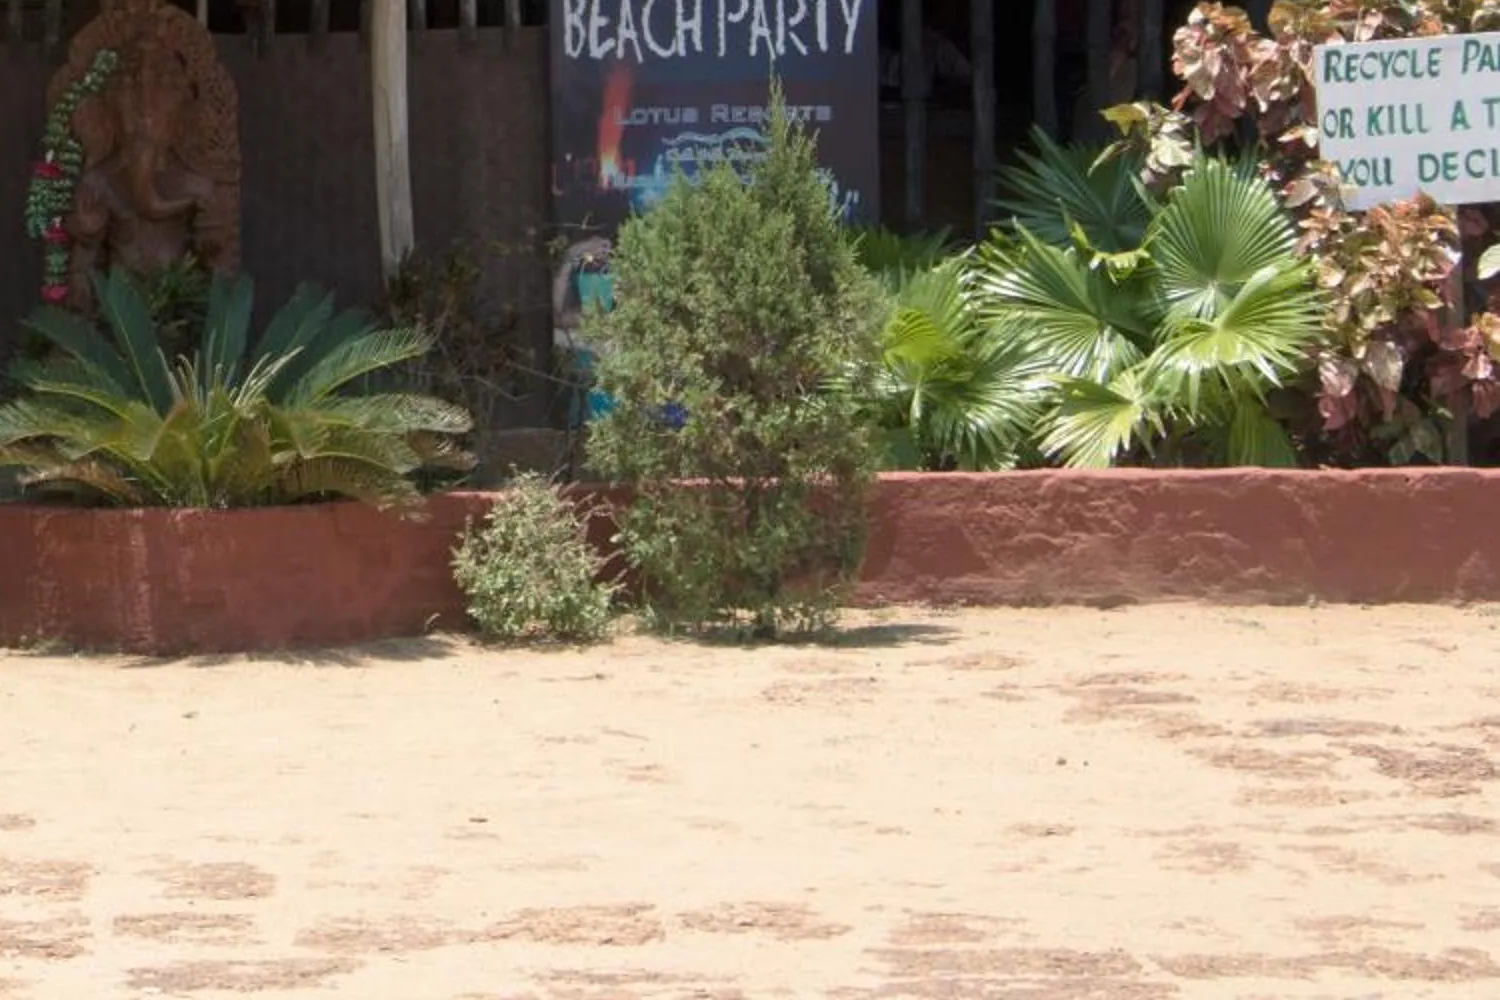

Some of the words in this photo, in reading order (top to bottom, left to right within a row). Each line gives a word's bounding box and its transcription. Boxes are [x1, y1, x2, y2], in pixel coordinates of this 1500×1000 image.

[1324, 48, 1442, 83] RECYCLE
[1461, 39, 1500, 75] PA
[613, 105, 699, 125] LOTUS
[1323, 108, 1355, 139] OR
[1367, 103, 1430, 136] KILL
[1451, 100, 1471, 131] A
[1337, 156, 1394, 186] YOU
